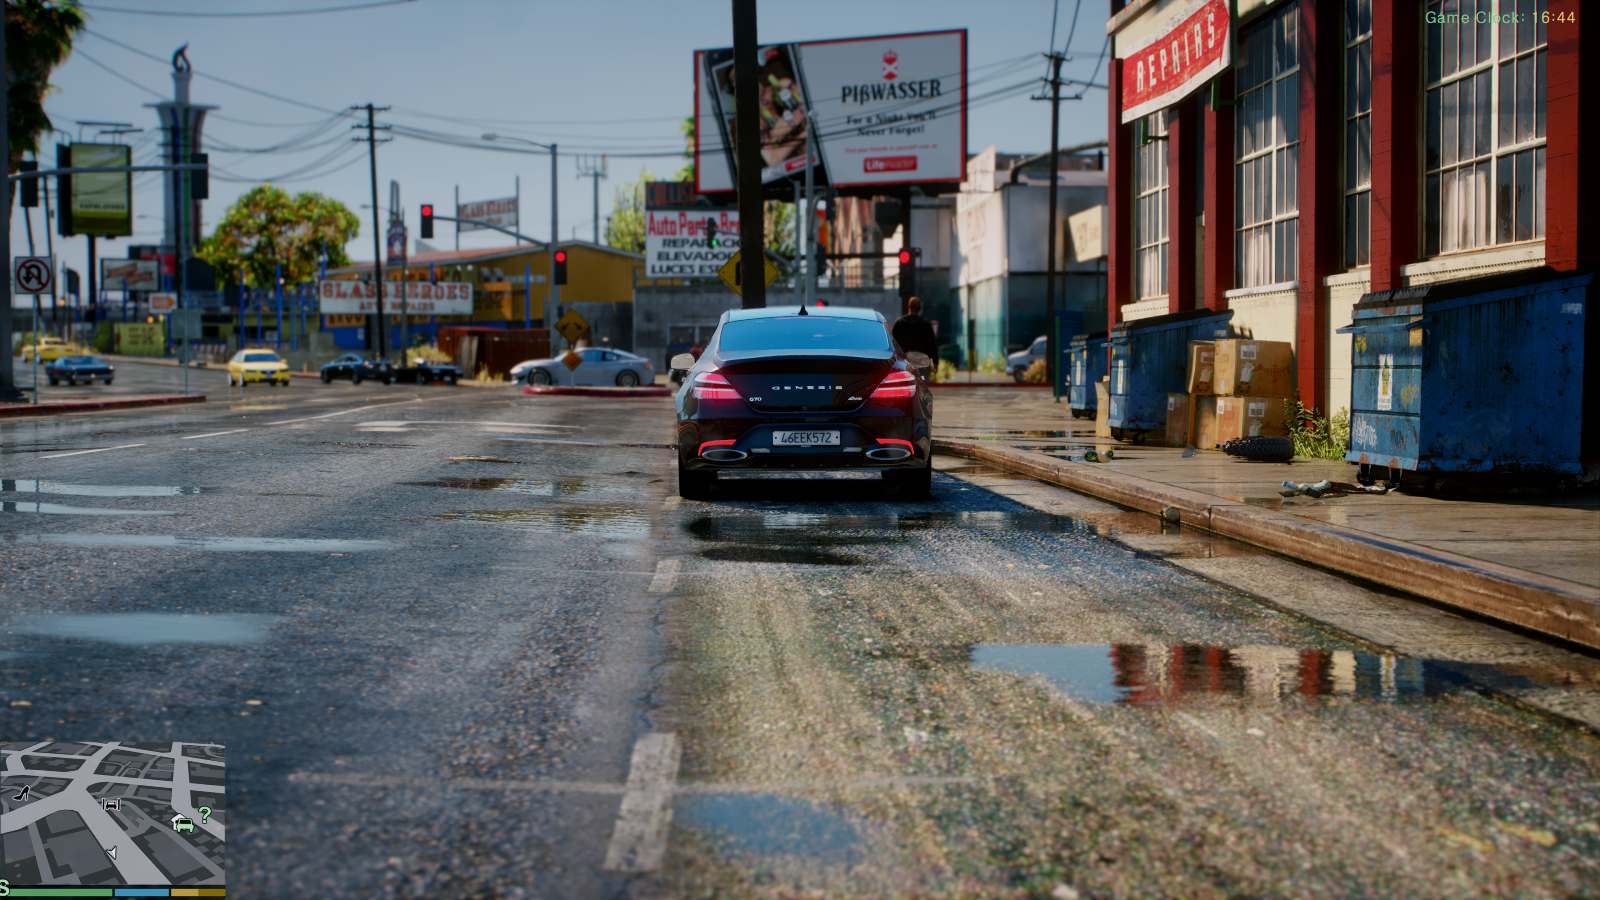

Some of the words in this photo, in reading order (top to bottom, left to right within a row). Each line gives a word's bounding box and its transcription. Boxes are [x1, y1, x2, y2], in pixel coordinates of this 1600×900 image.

[1136, 12, 1215, 93] REPAIRS
[846, 115, 862, 125] For
[866, 116, 872, 124] a
[875, 112, 903, 124] Night
[857, 127, 885, 137] Never
[889, 124, 925, 137] Forget!
[646, 182, 698, 206] COLLISI
[648, 211, 677, 236] Auto
[651, 264, 695, 275] LUCES
[322, 282, 388, 299] GLASS
[394, 283, 470, 300] HEROES
[359, 302, 387, 311] AUO
[781, 432, 832, 443] 46EEK572
